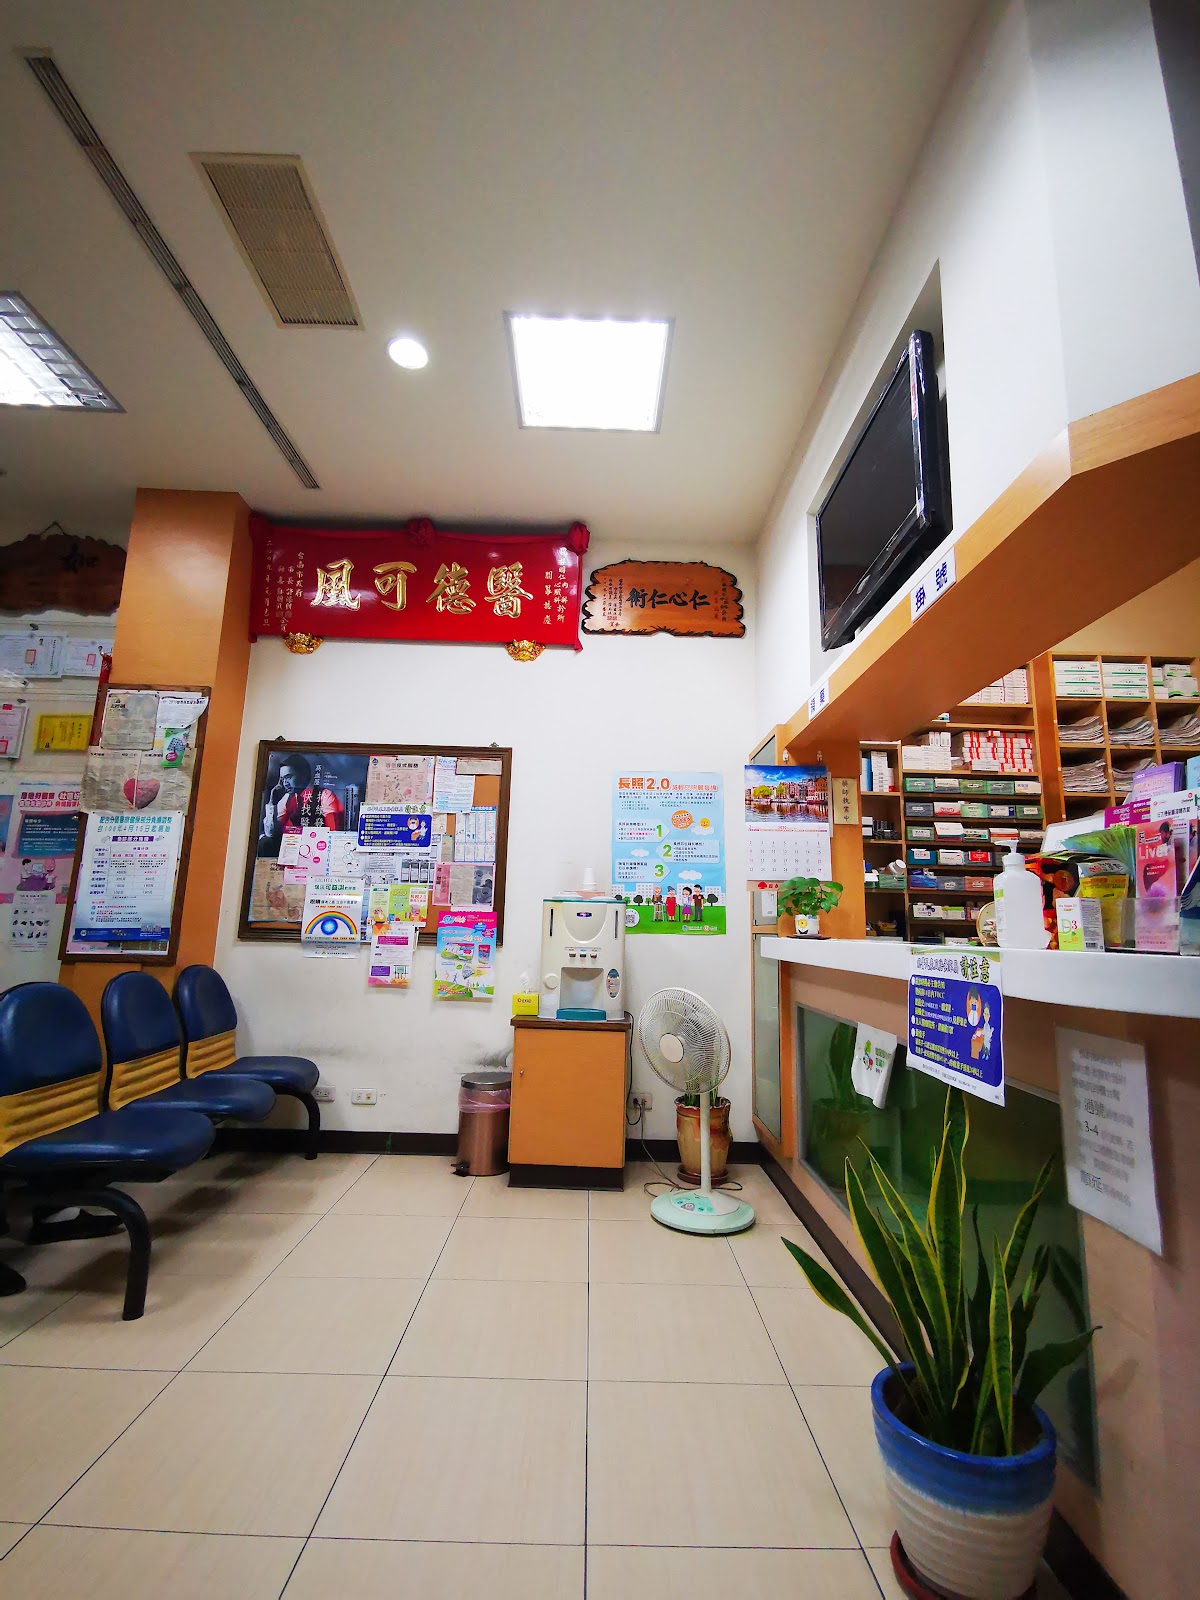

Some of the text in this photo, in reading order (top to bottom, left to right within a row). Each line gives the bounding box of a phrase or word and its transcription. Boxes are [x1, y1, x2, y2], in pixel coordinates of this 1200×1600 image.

[310, 558, 534, 619] 醫德可風
[915, 562, 948, 612] 掛號
[626, 587, 710, 610] 仁心仁術
[618, 777, 670, 790] 長照2.0
[656, 824, 662, 837] 1
[663, 845, 672, 857] 2
[654, 864, 664, 877] 3
[960, 956, 990, 983] 請注意
[1084, 1120, 1099, 1136] 3-4
